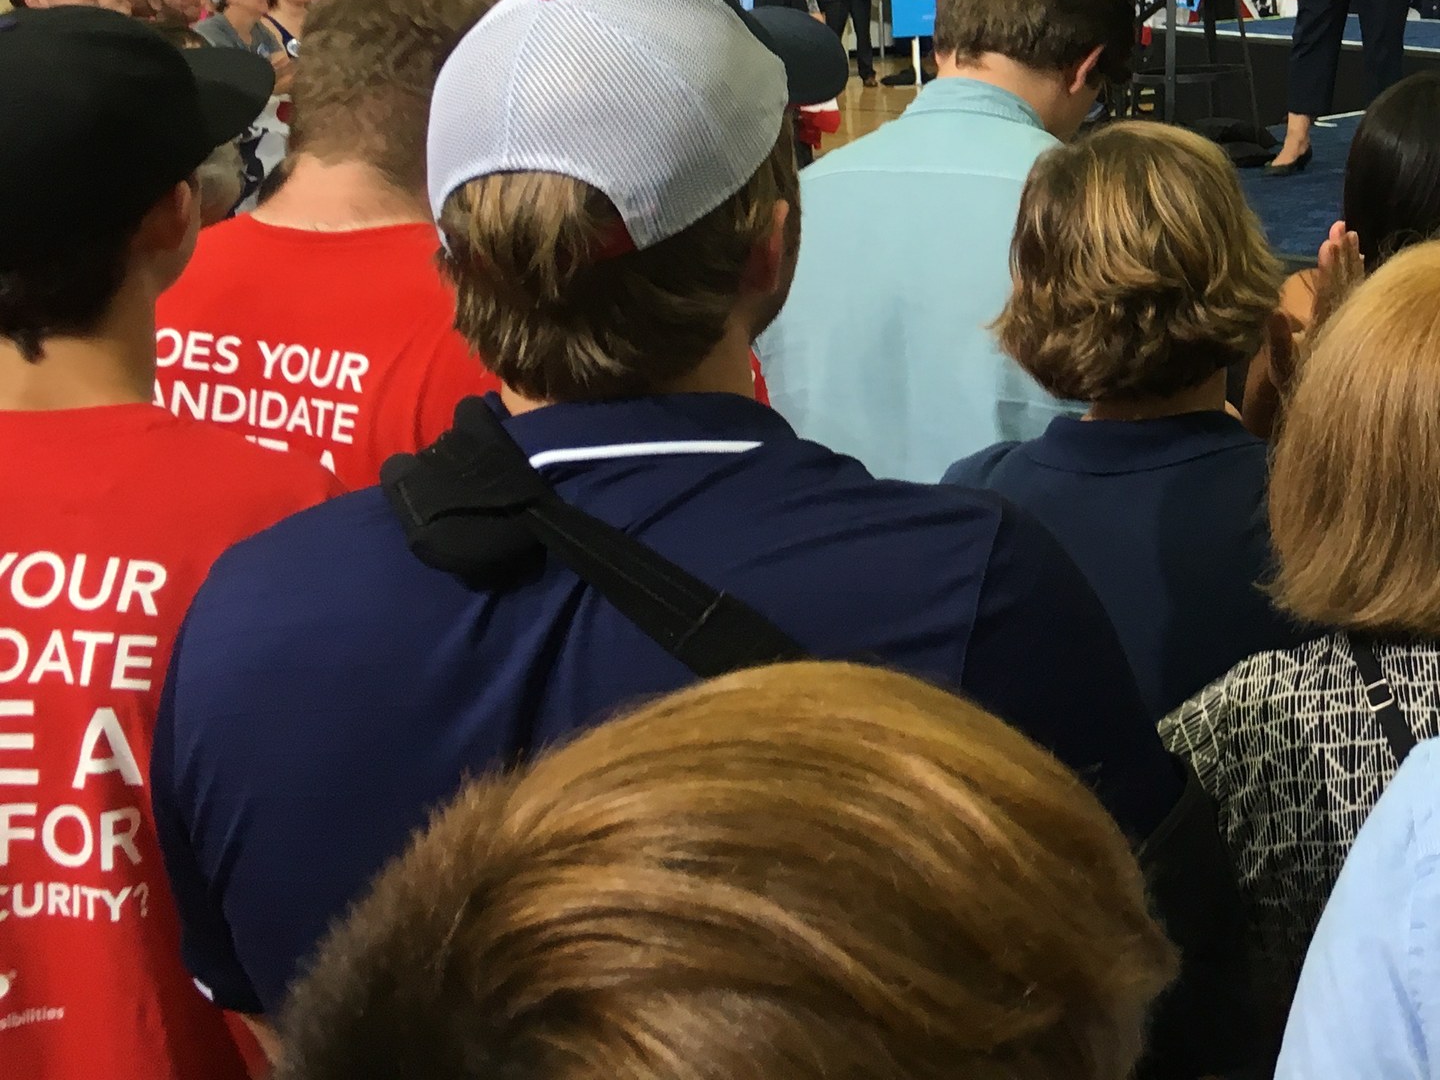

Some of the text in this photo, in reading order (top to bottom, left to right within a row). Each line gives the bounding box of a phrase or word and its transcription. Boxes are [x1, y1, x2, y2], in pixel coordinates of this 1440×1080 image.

[156, 327, 369, 394] OES YOUR
[72, 707, 144, 790] A
